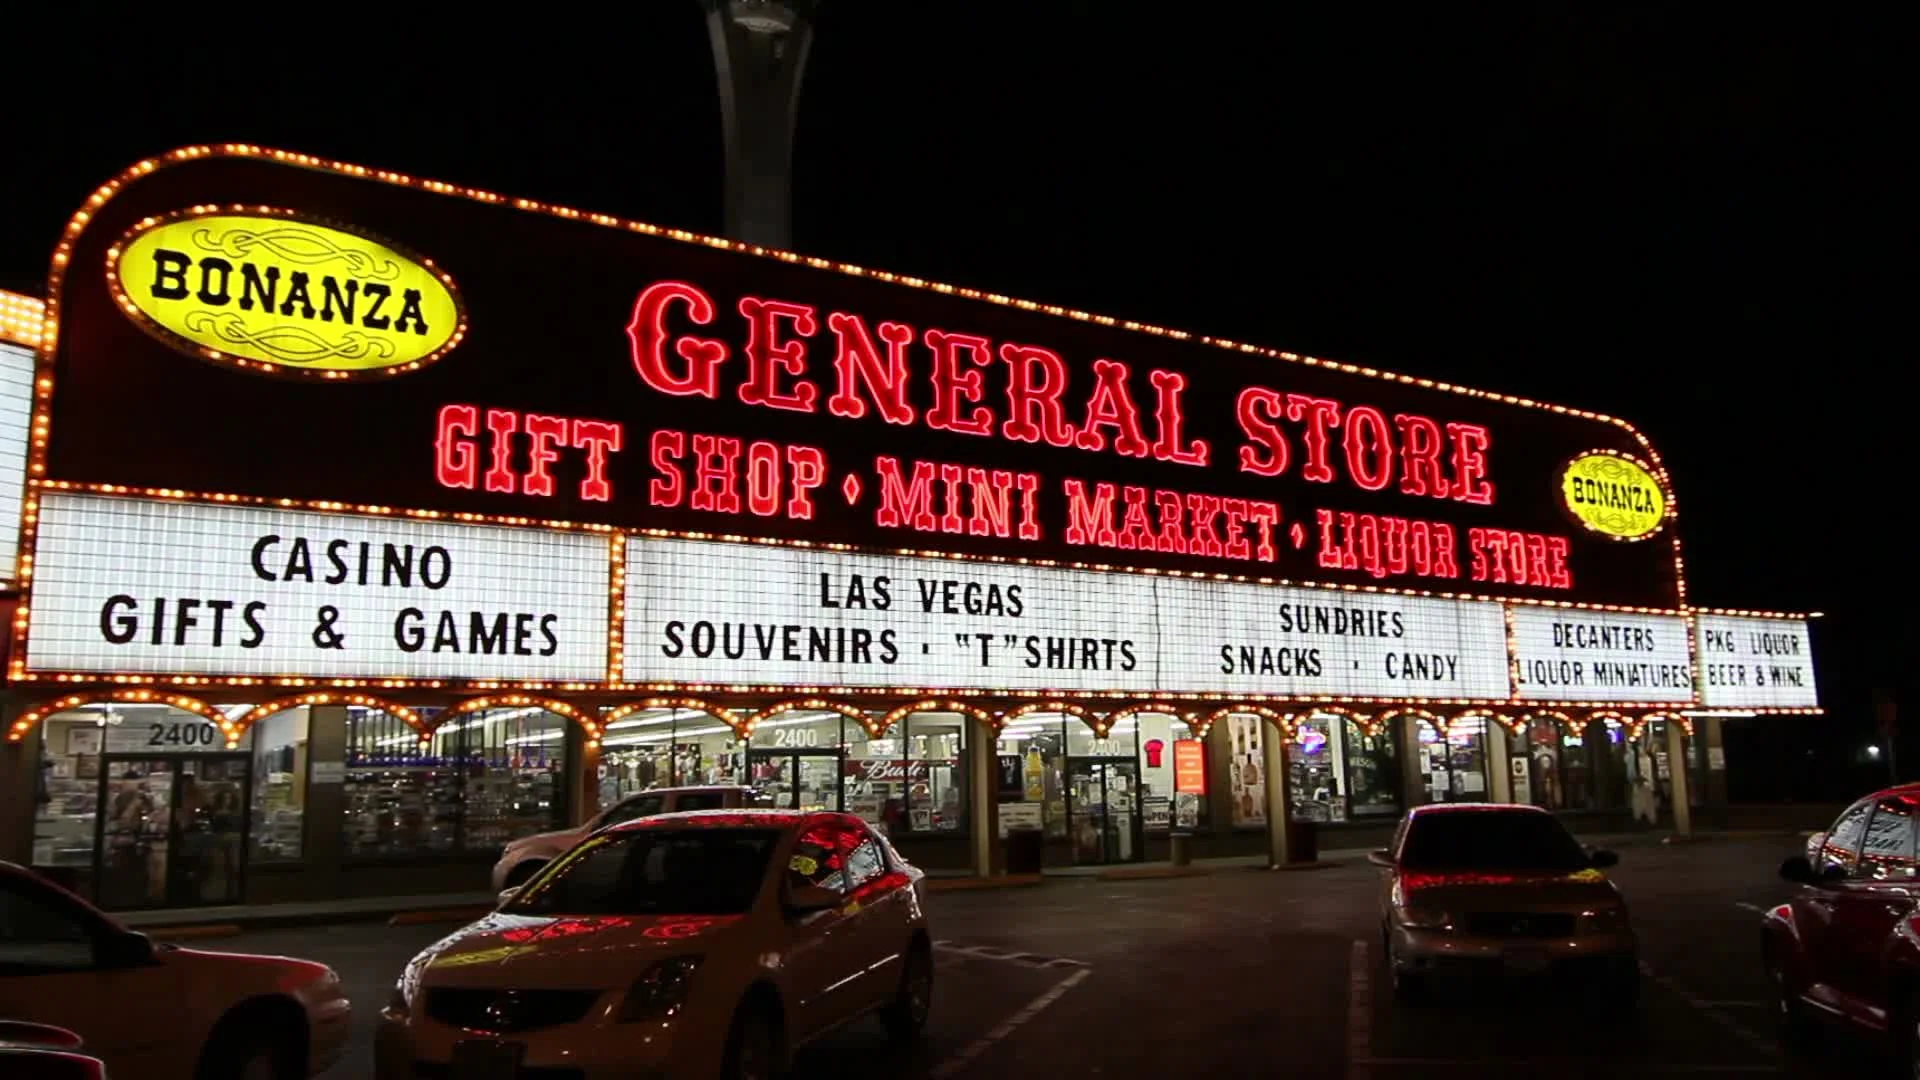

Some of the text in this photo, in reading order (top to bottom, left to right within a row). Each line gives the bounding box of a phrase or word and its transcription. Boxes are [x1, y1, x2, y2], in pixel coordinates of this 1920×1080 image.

[150, 248, 430, 336] BONANZA
[626, 281, 1494, 506] GENERAL STORE
[434, 403, 1573, 589] GIFT SHOP MINI MARKET LIQUOR STORE
[1572, 476, 1655, 514] BONANZA
[250, 534, 452, 589] CASINO
[820, 572, 1024, 617] LAS VEGAS
[100, 594, 558, 657] GIFTS & GAMES
[1279, 603, 1404, 638] SUNDRIES
[1553, 622, 1654, 651] DECANTERS
[661, 620, 898, 664] SOUVENIRS
[1751, 633, 1800, 655] LIQUOR
[1220, 645, 1457, 682] SNACKS CANDY
[1516, 658, 1690, 688] LIQUOR MINIATURES
[1708, 663, 1746, 686] BEER
[1769, 666, 1804, 687] WINE
[148, 724, 214, 746] 2400
[775, 728, 818, 748] 2400
